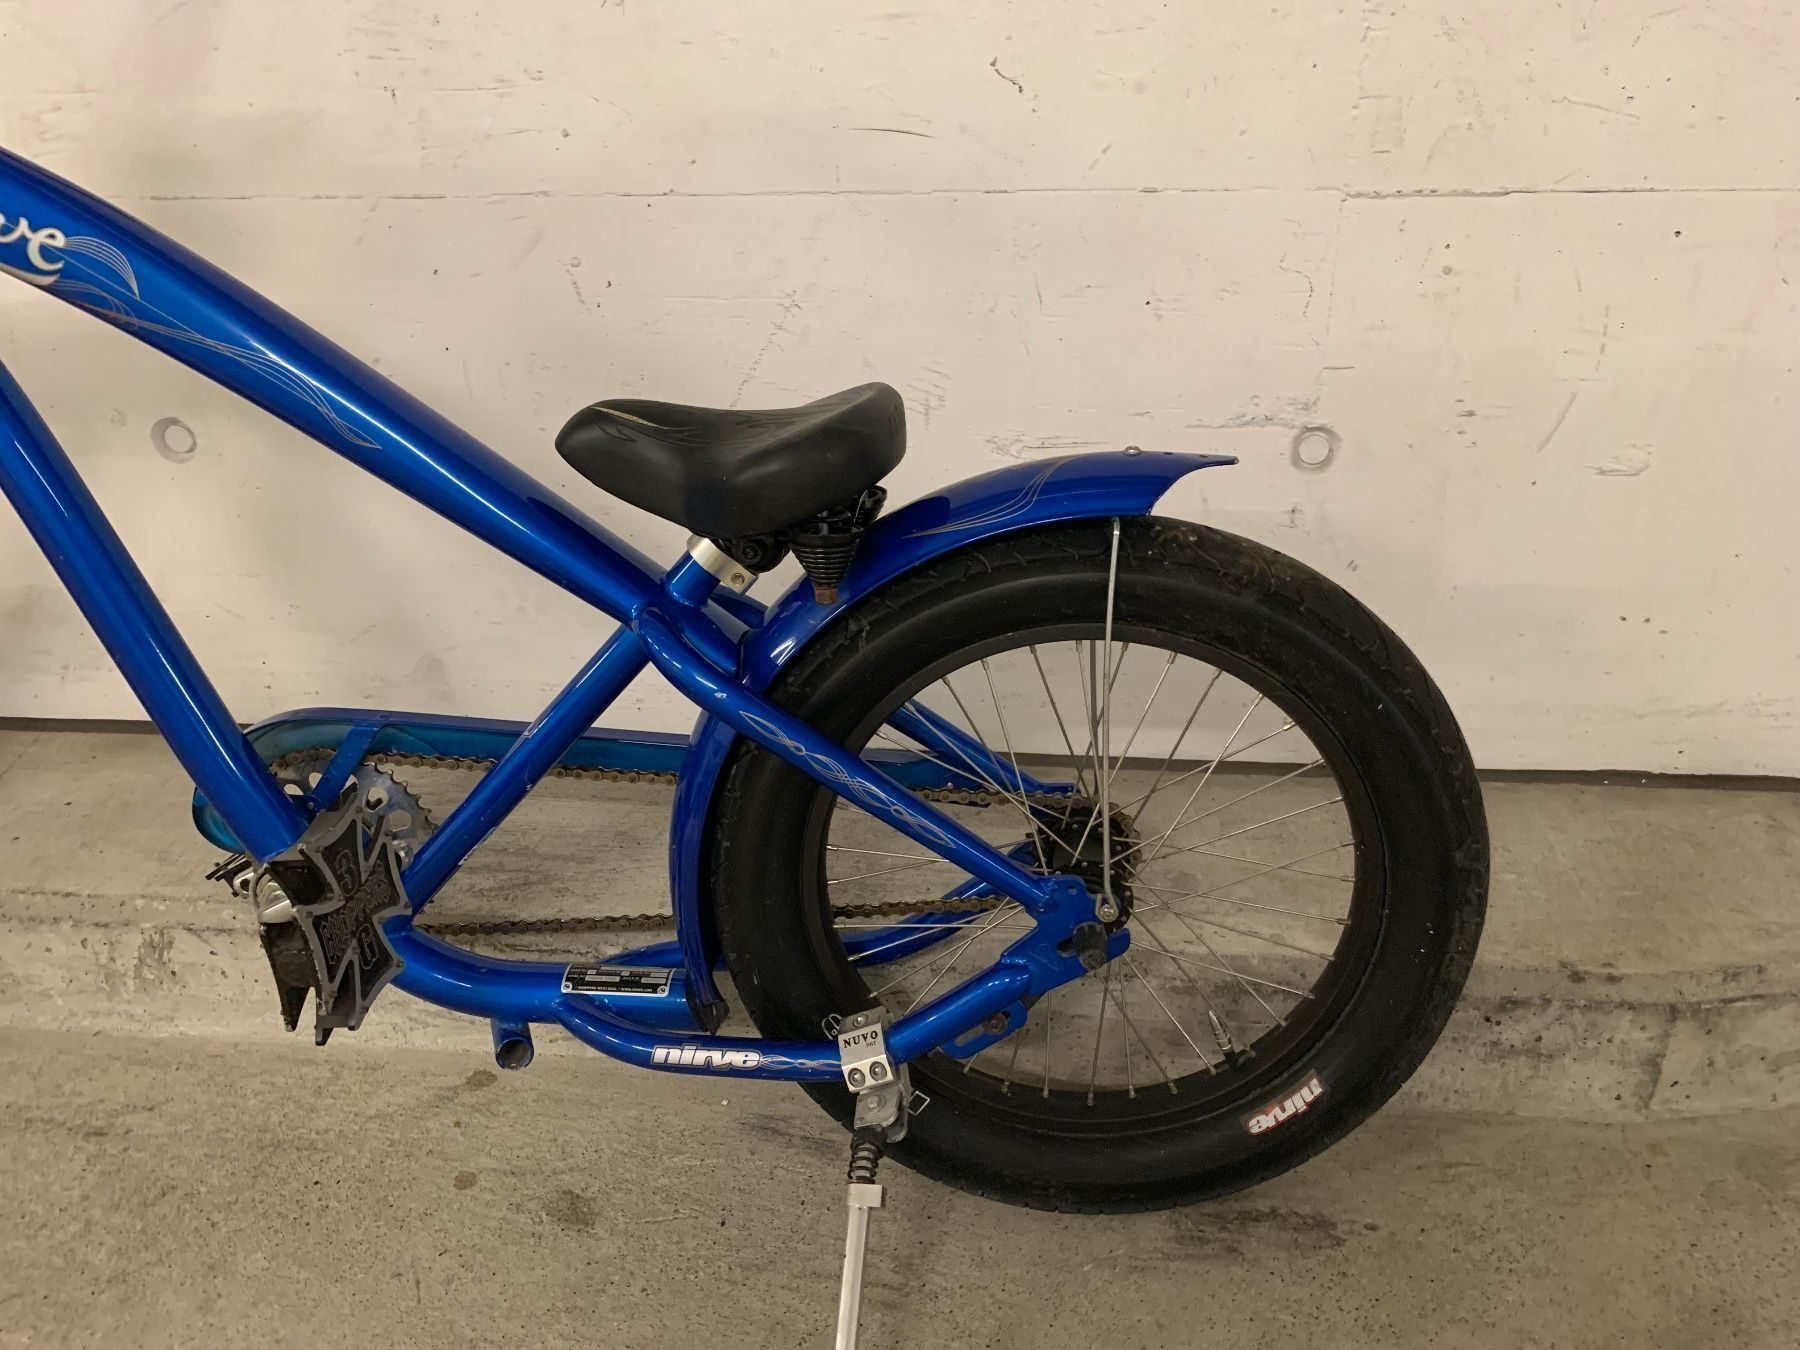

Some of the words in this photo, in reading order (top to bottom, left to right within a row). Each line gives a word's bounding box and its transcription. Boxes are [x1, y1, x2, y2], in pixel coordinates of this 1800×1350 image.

[843, 1030, 879, 1048] NUVO
[652, 1044, 761, 1069] nirve
[1248, 1078, 1323, 1134] nirve
